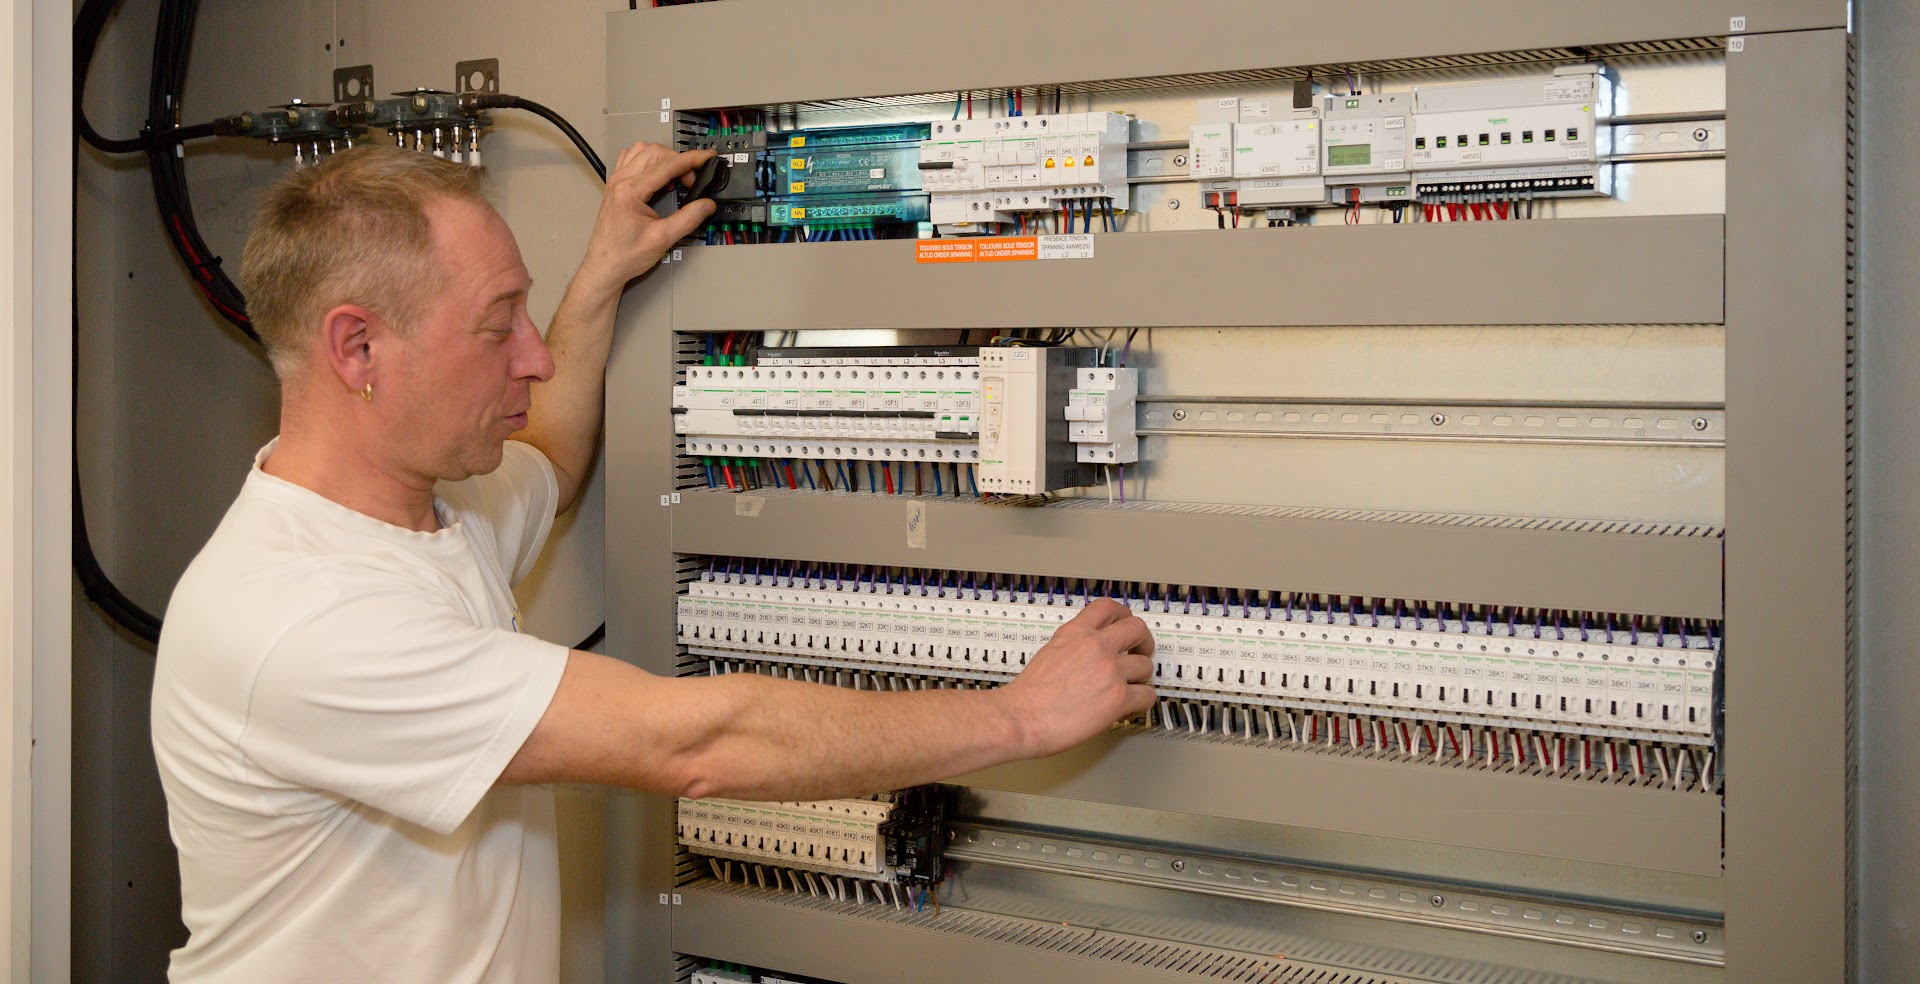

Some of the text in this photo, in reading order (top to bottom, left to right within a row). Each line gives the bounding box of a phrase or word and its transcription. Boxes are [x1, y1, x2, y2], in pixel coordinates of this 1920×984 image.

[1732, 20, 1744, 28] 10
[1730, 41, 1742, 49] 10
[1512, 672, 1529, 680] 38K2
[1537, 674, 1554, 682] 38K3
[1561, 676, 1578, 684] 38K5
[1611, 680, 1629, 688] 38K7
[1637, 682, 1655, 690] 39K1
[1664, 684, 1681, 692] 39K2
[1690, 686, 1708, 694] 39K3
